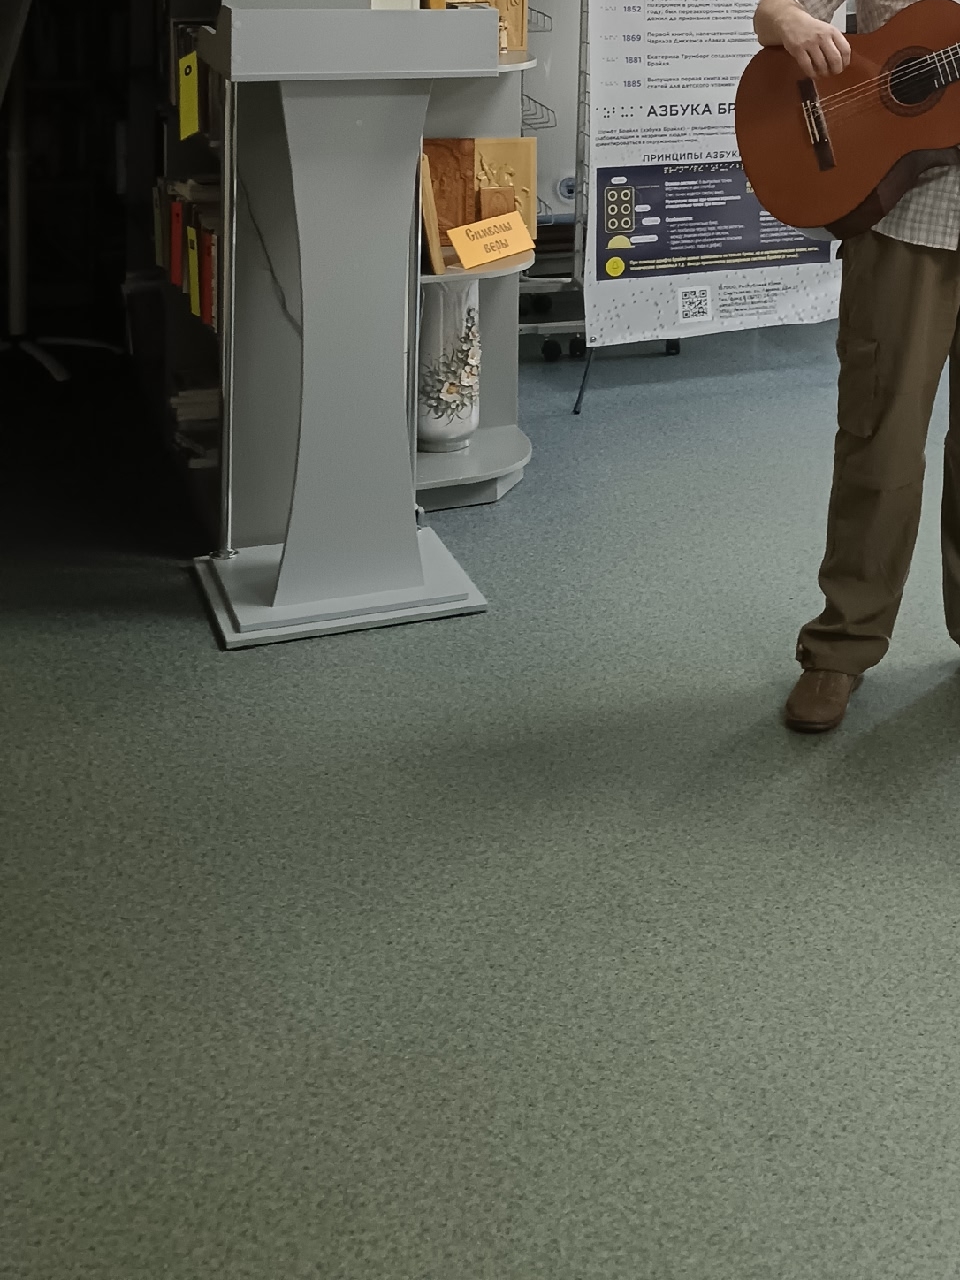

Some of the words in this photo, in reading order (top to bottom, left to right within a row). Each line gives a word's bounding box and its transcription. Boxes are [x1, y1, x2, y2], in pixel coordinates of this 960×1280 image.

[622, 34, 642, 42] 1869
[625, 56, 642, 64] 1881
[623, 80, 642, 88] 1885
[647, 103, 712, 117] АЗБУКА
[718, 103, 736, 115] БР
[643, 151, 703, 163] ПРИНЦИПЫ
[705, 150, 738, 160] АЗБУК
